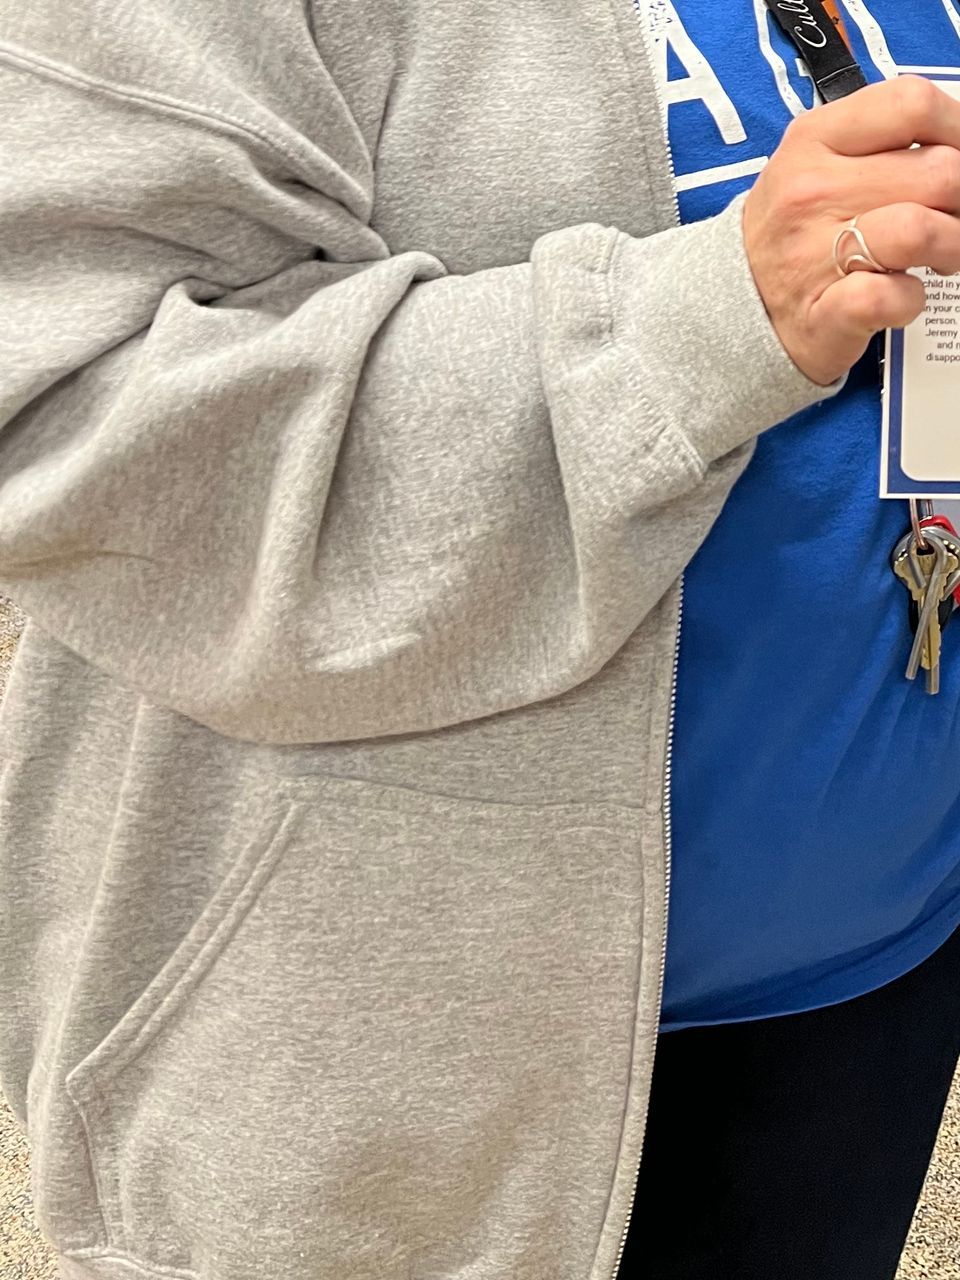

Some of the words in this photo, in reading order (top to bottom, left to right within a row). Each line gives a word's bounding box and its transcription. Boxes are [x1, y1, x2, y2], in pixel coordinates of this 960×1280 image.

[932, 305, 952, 314] your
[924, 318, 957, 327] person.
[924, 328, 958, 339] Jeremy
[936, 340, 953, 349] and
